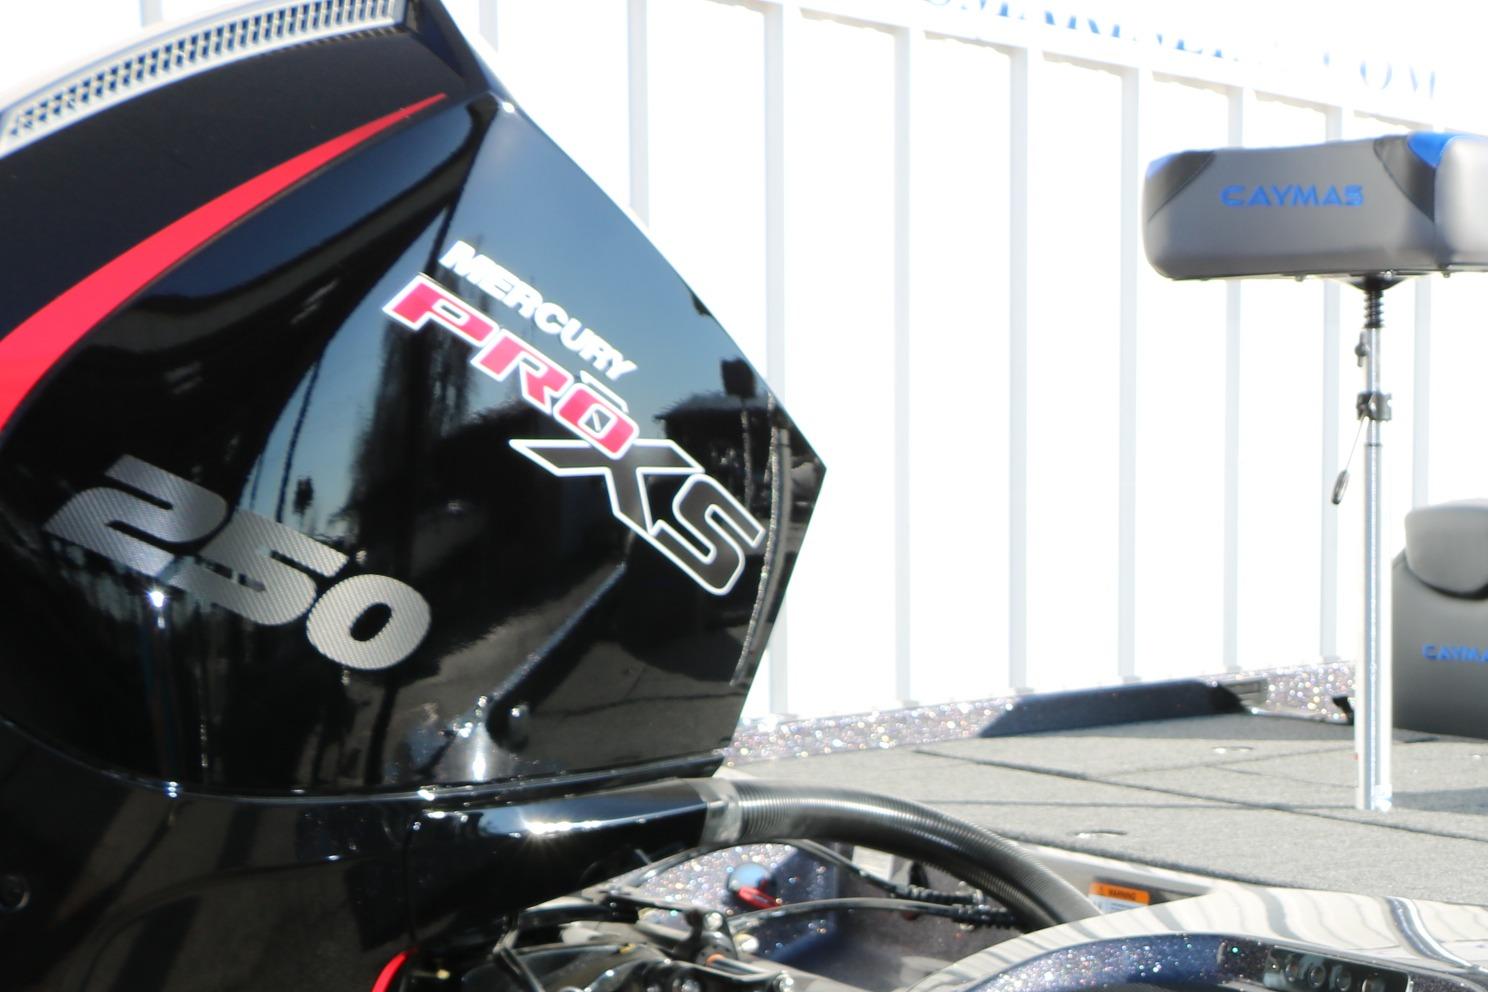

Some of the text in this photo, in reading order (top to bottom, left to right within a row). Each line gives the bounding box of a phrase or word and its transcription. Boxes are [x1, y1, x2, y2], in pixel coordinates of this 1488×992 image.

[1220, 183, 1363, 208] CAYMAS
[382, 274, 640, 460] PRO
[439, 240, 638, 381] MERCURY
[43, 454, 432, 670] 250
[509, 438, 766, 595] XS
